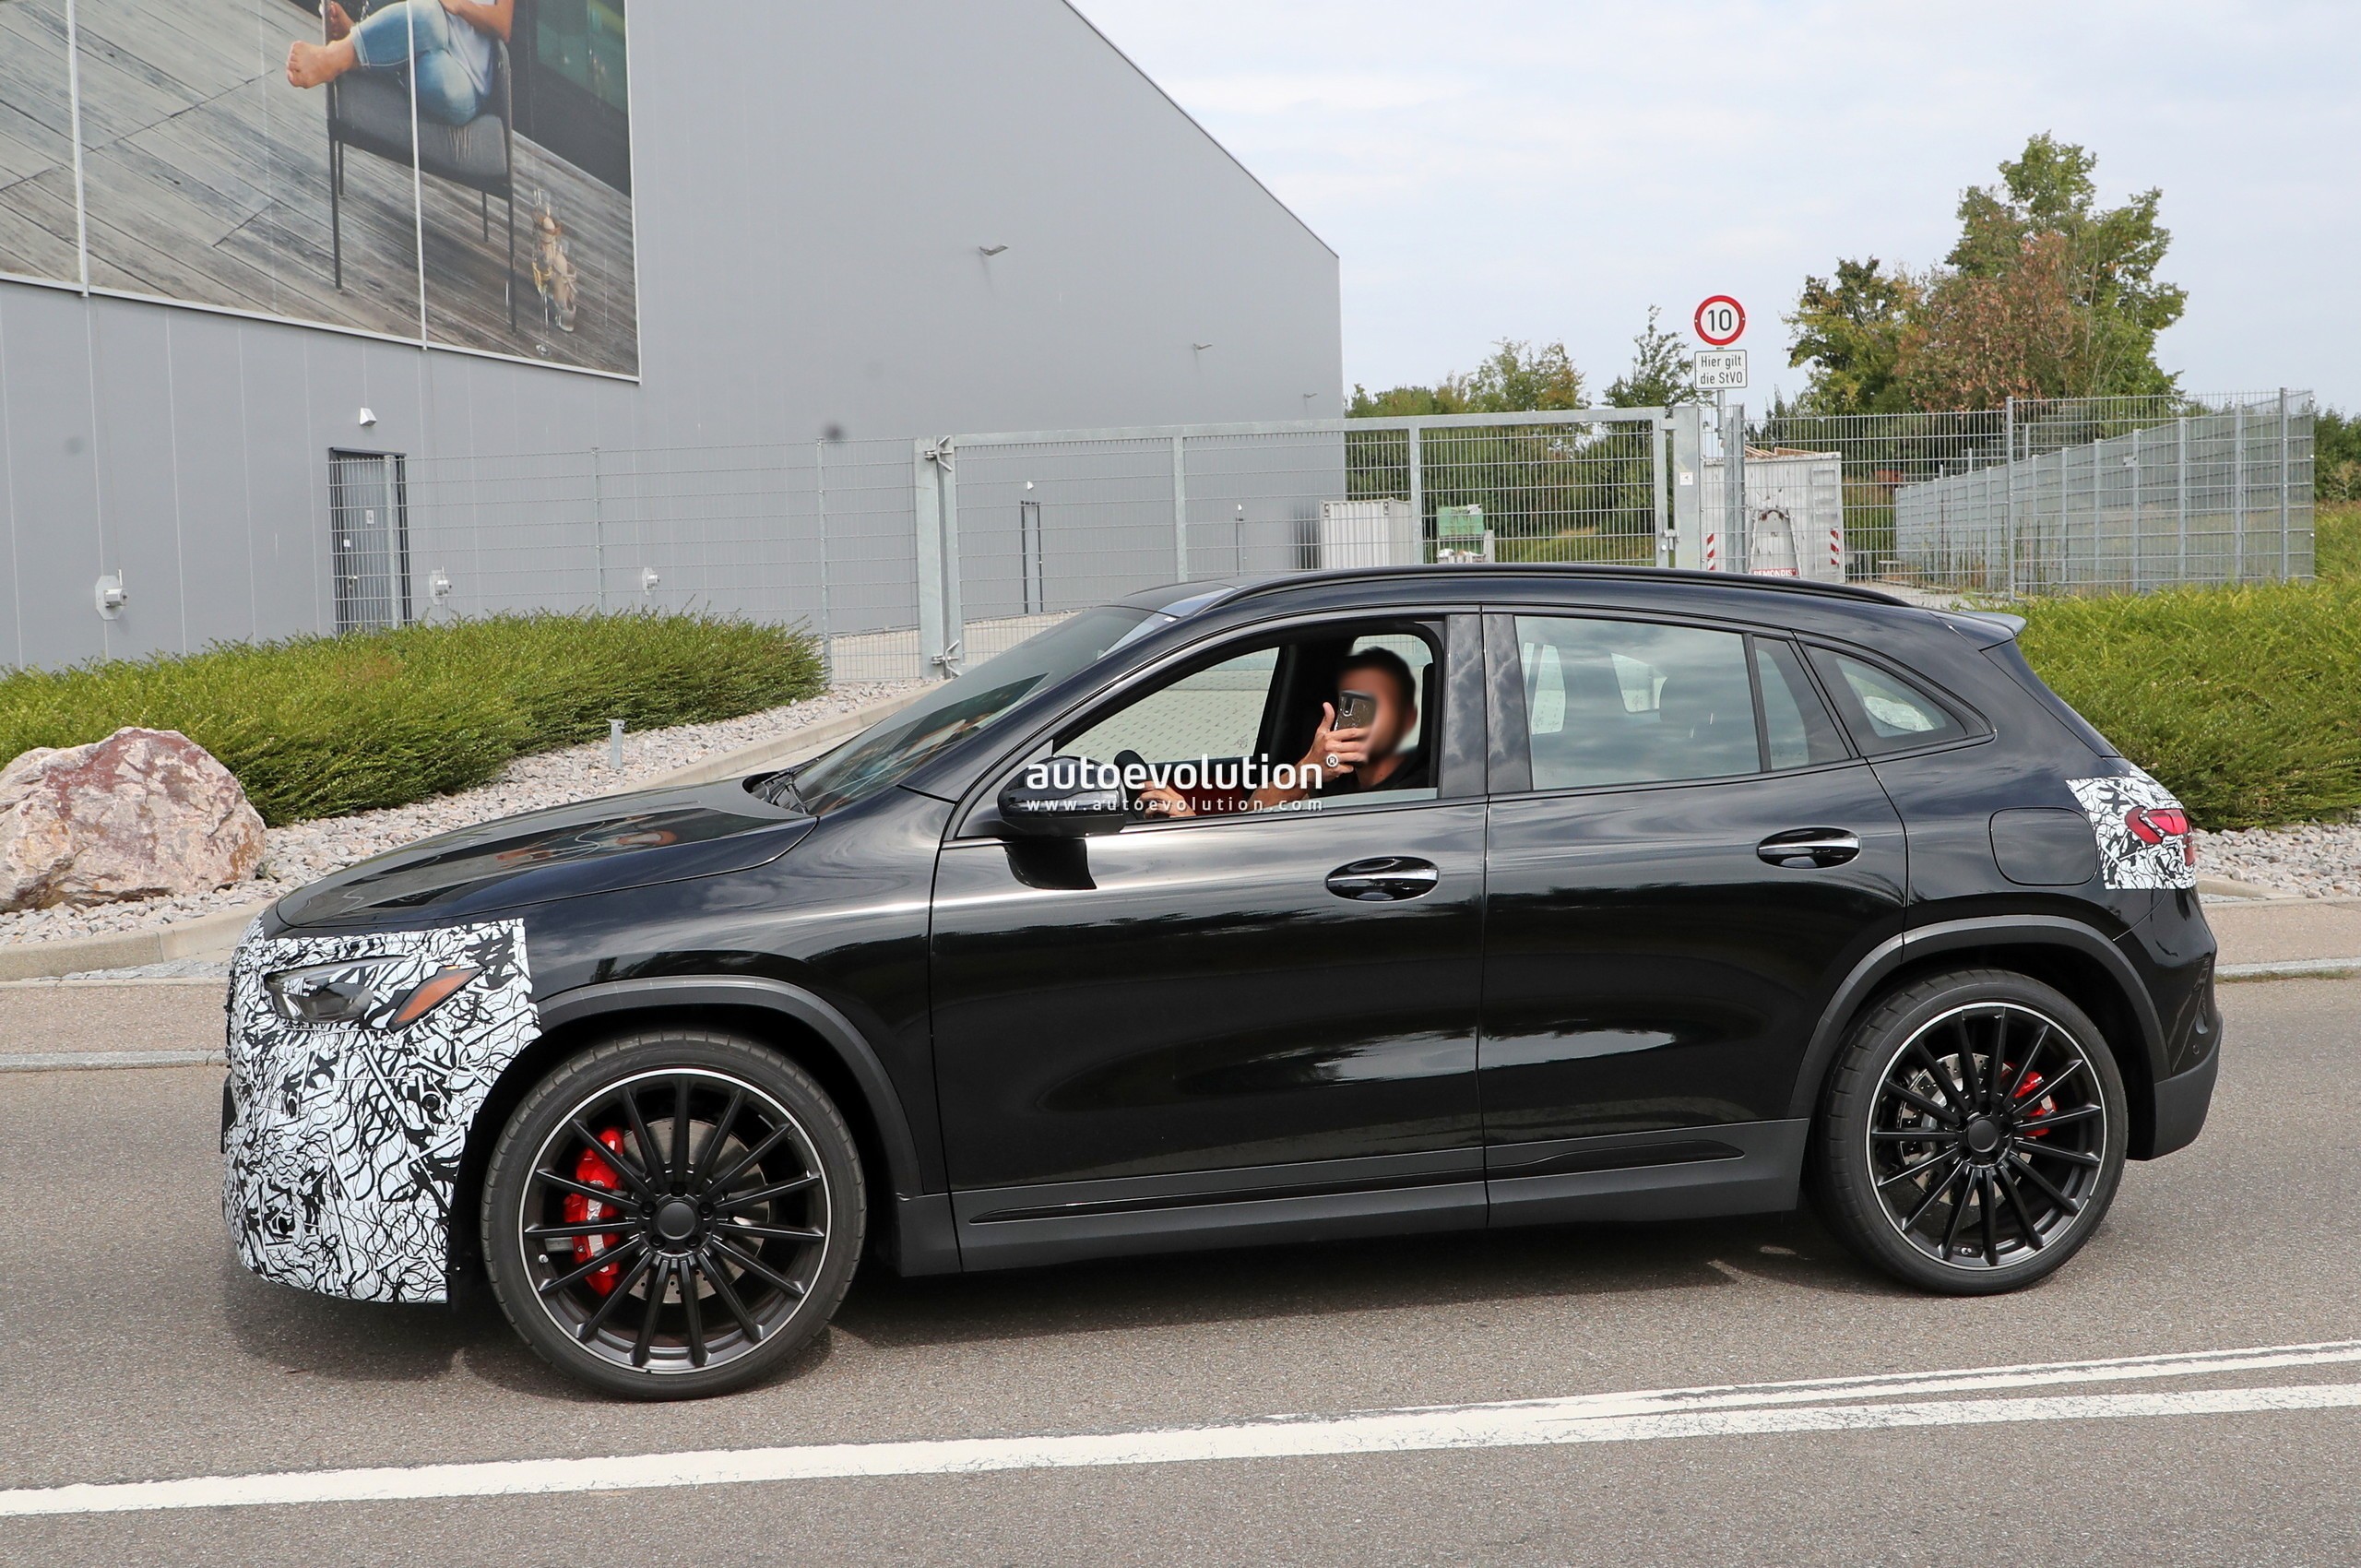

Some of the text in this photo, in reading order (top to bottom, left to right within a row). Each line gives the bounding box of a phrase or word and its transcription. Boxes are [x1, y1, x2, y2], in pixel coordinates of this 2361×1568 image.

[1707, 309, 1732, 331] 10
[1701, 355, 1741, 369] Hier gilt
[1700, 371, 1743, 385] die StVO
